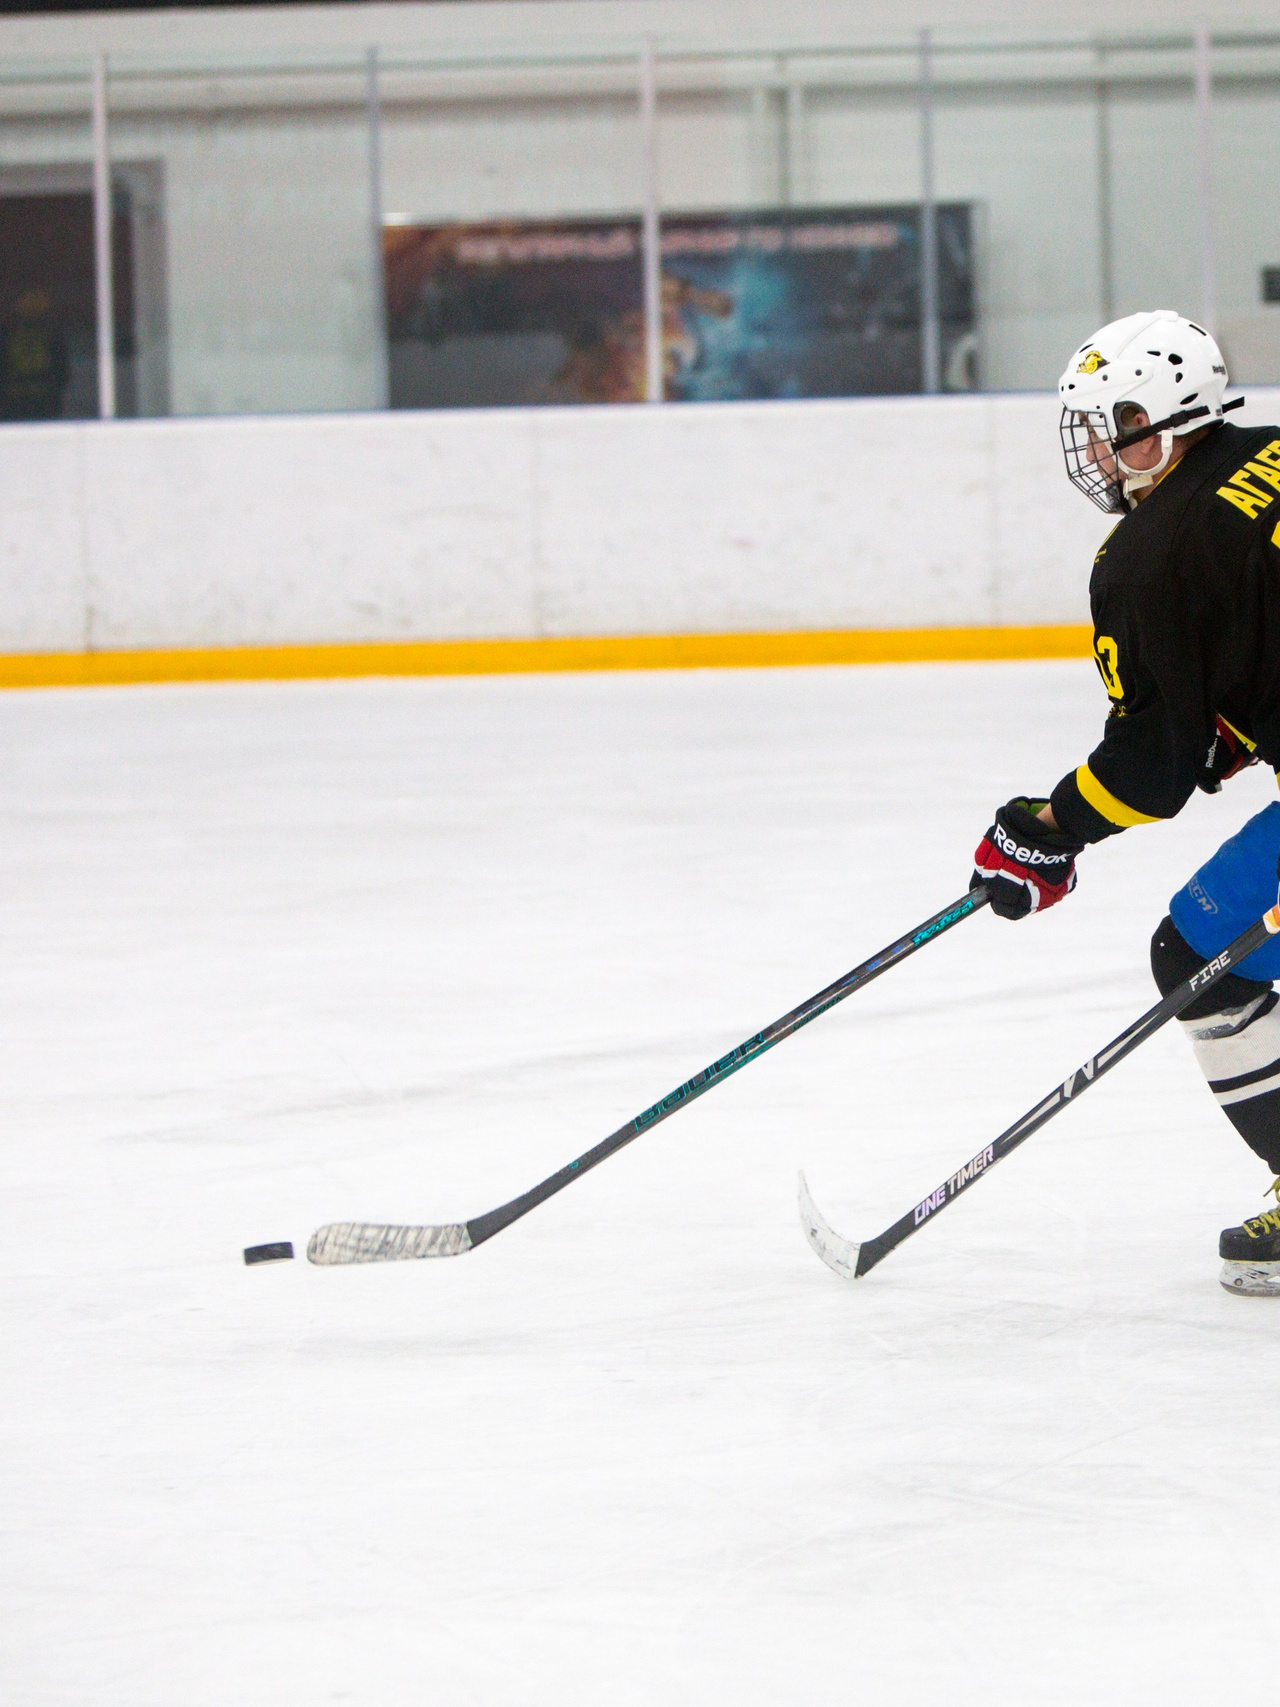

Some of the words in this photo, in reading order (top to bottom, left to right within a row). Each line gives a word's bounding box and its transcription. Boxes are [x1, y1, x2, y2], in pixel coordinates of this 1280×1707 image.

[993, 824, 1074, 865] Reebok
[1188, 950, 1231, 992] FIRE
[914, 1185, 946, 1226] ONE
[947, 1144, 995, 1195] TIMER
